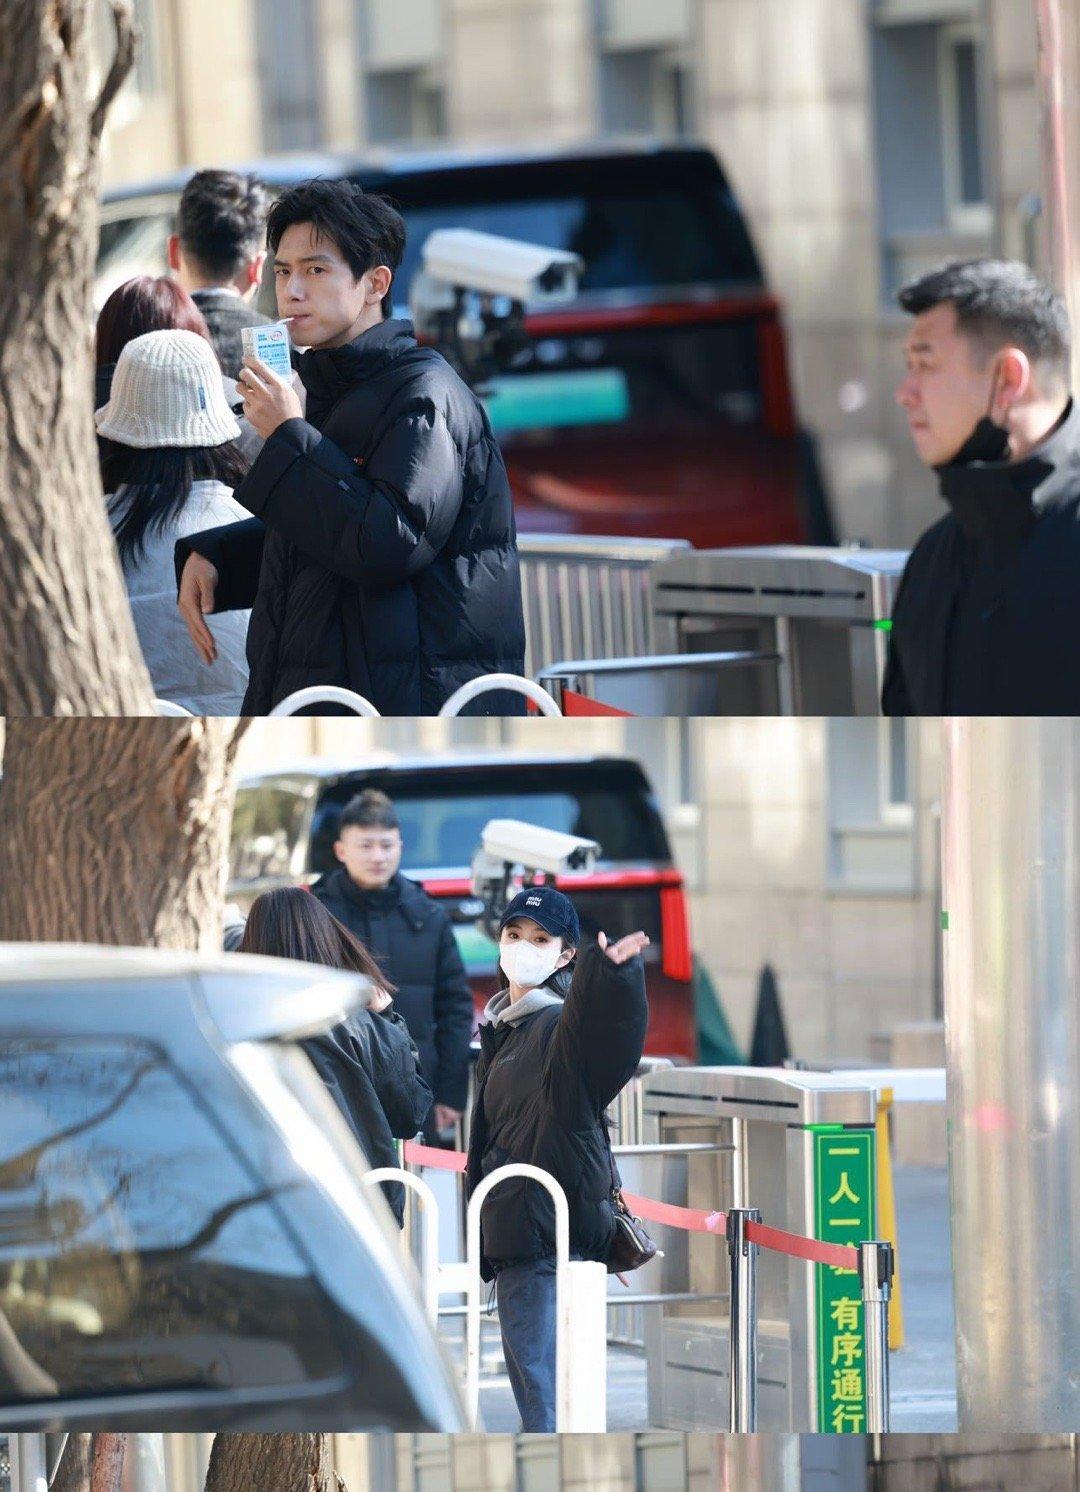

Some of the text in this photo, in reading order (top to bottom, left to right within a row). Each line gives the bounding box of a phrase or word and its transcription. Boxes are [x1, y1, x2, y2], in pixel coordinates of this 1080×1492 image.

[829, 1148, 864, 1433] 一人一 有序通行
